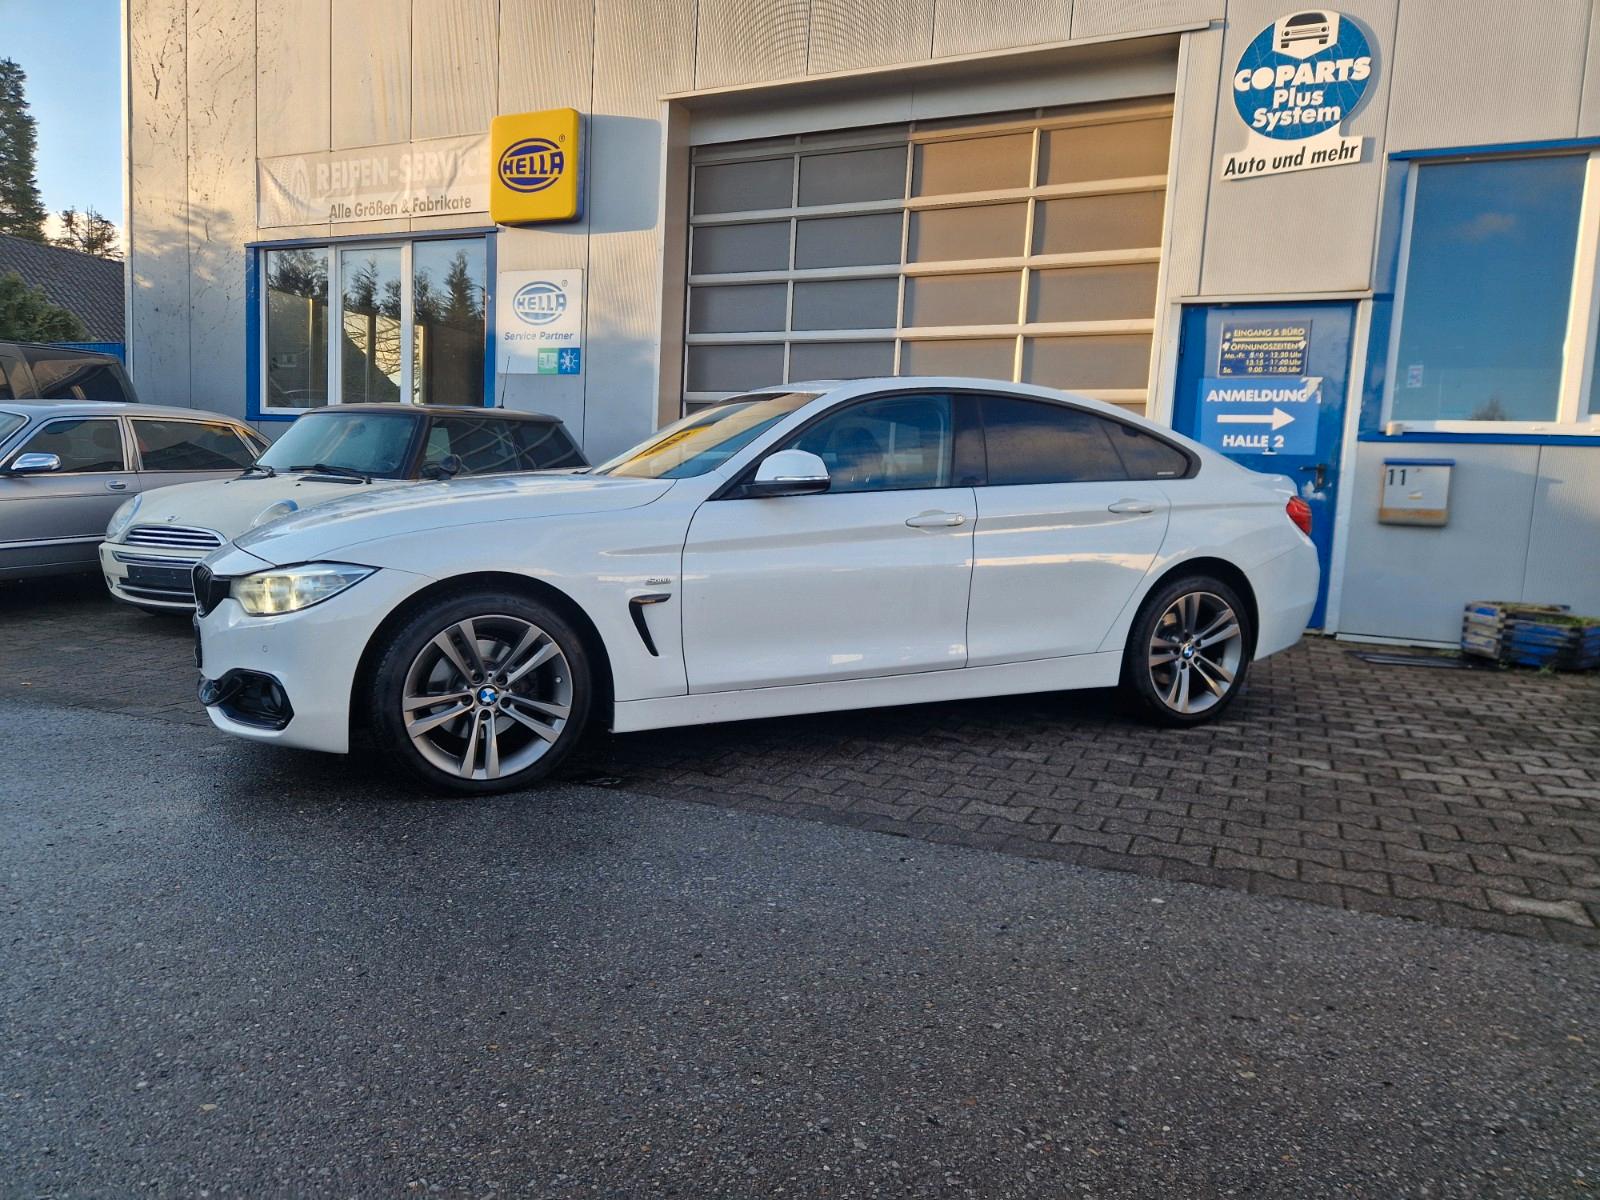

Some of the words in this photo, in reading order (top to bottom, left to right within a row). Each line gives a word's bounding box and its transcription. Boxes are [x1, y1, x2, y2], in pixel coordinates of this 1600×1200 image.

[1234, 56, 1372, 92] COPARTS
[1273, 87, 1324, 108] Plus
[1251, 105, 1341, 132] System
[503, 151, 565, 175] HELLA
[1223, 157, 1266, 177] Auto
[1272, 146, 1307, 170] und
[1311, 140, 1359, 164] mehr
[329, 204, 351, 219] Alle
[354, 200, 398, 218] Größen
[412, 195, 472, 213] Fabrikate
[516, 293, 567, 312] HELLA
[504, 331, 537, 341] Service
[539, 331, 574, 341] Partner
[1233, 328, 1272, 337] EINGANG
[1222, 434, 1269, 448] HALLE
[1273, 435, 1285, 448] 2
